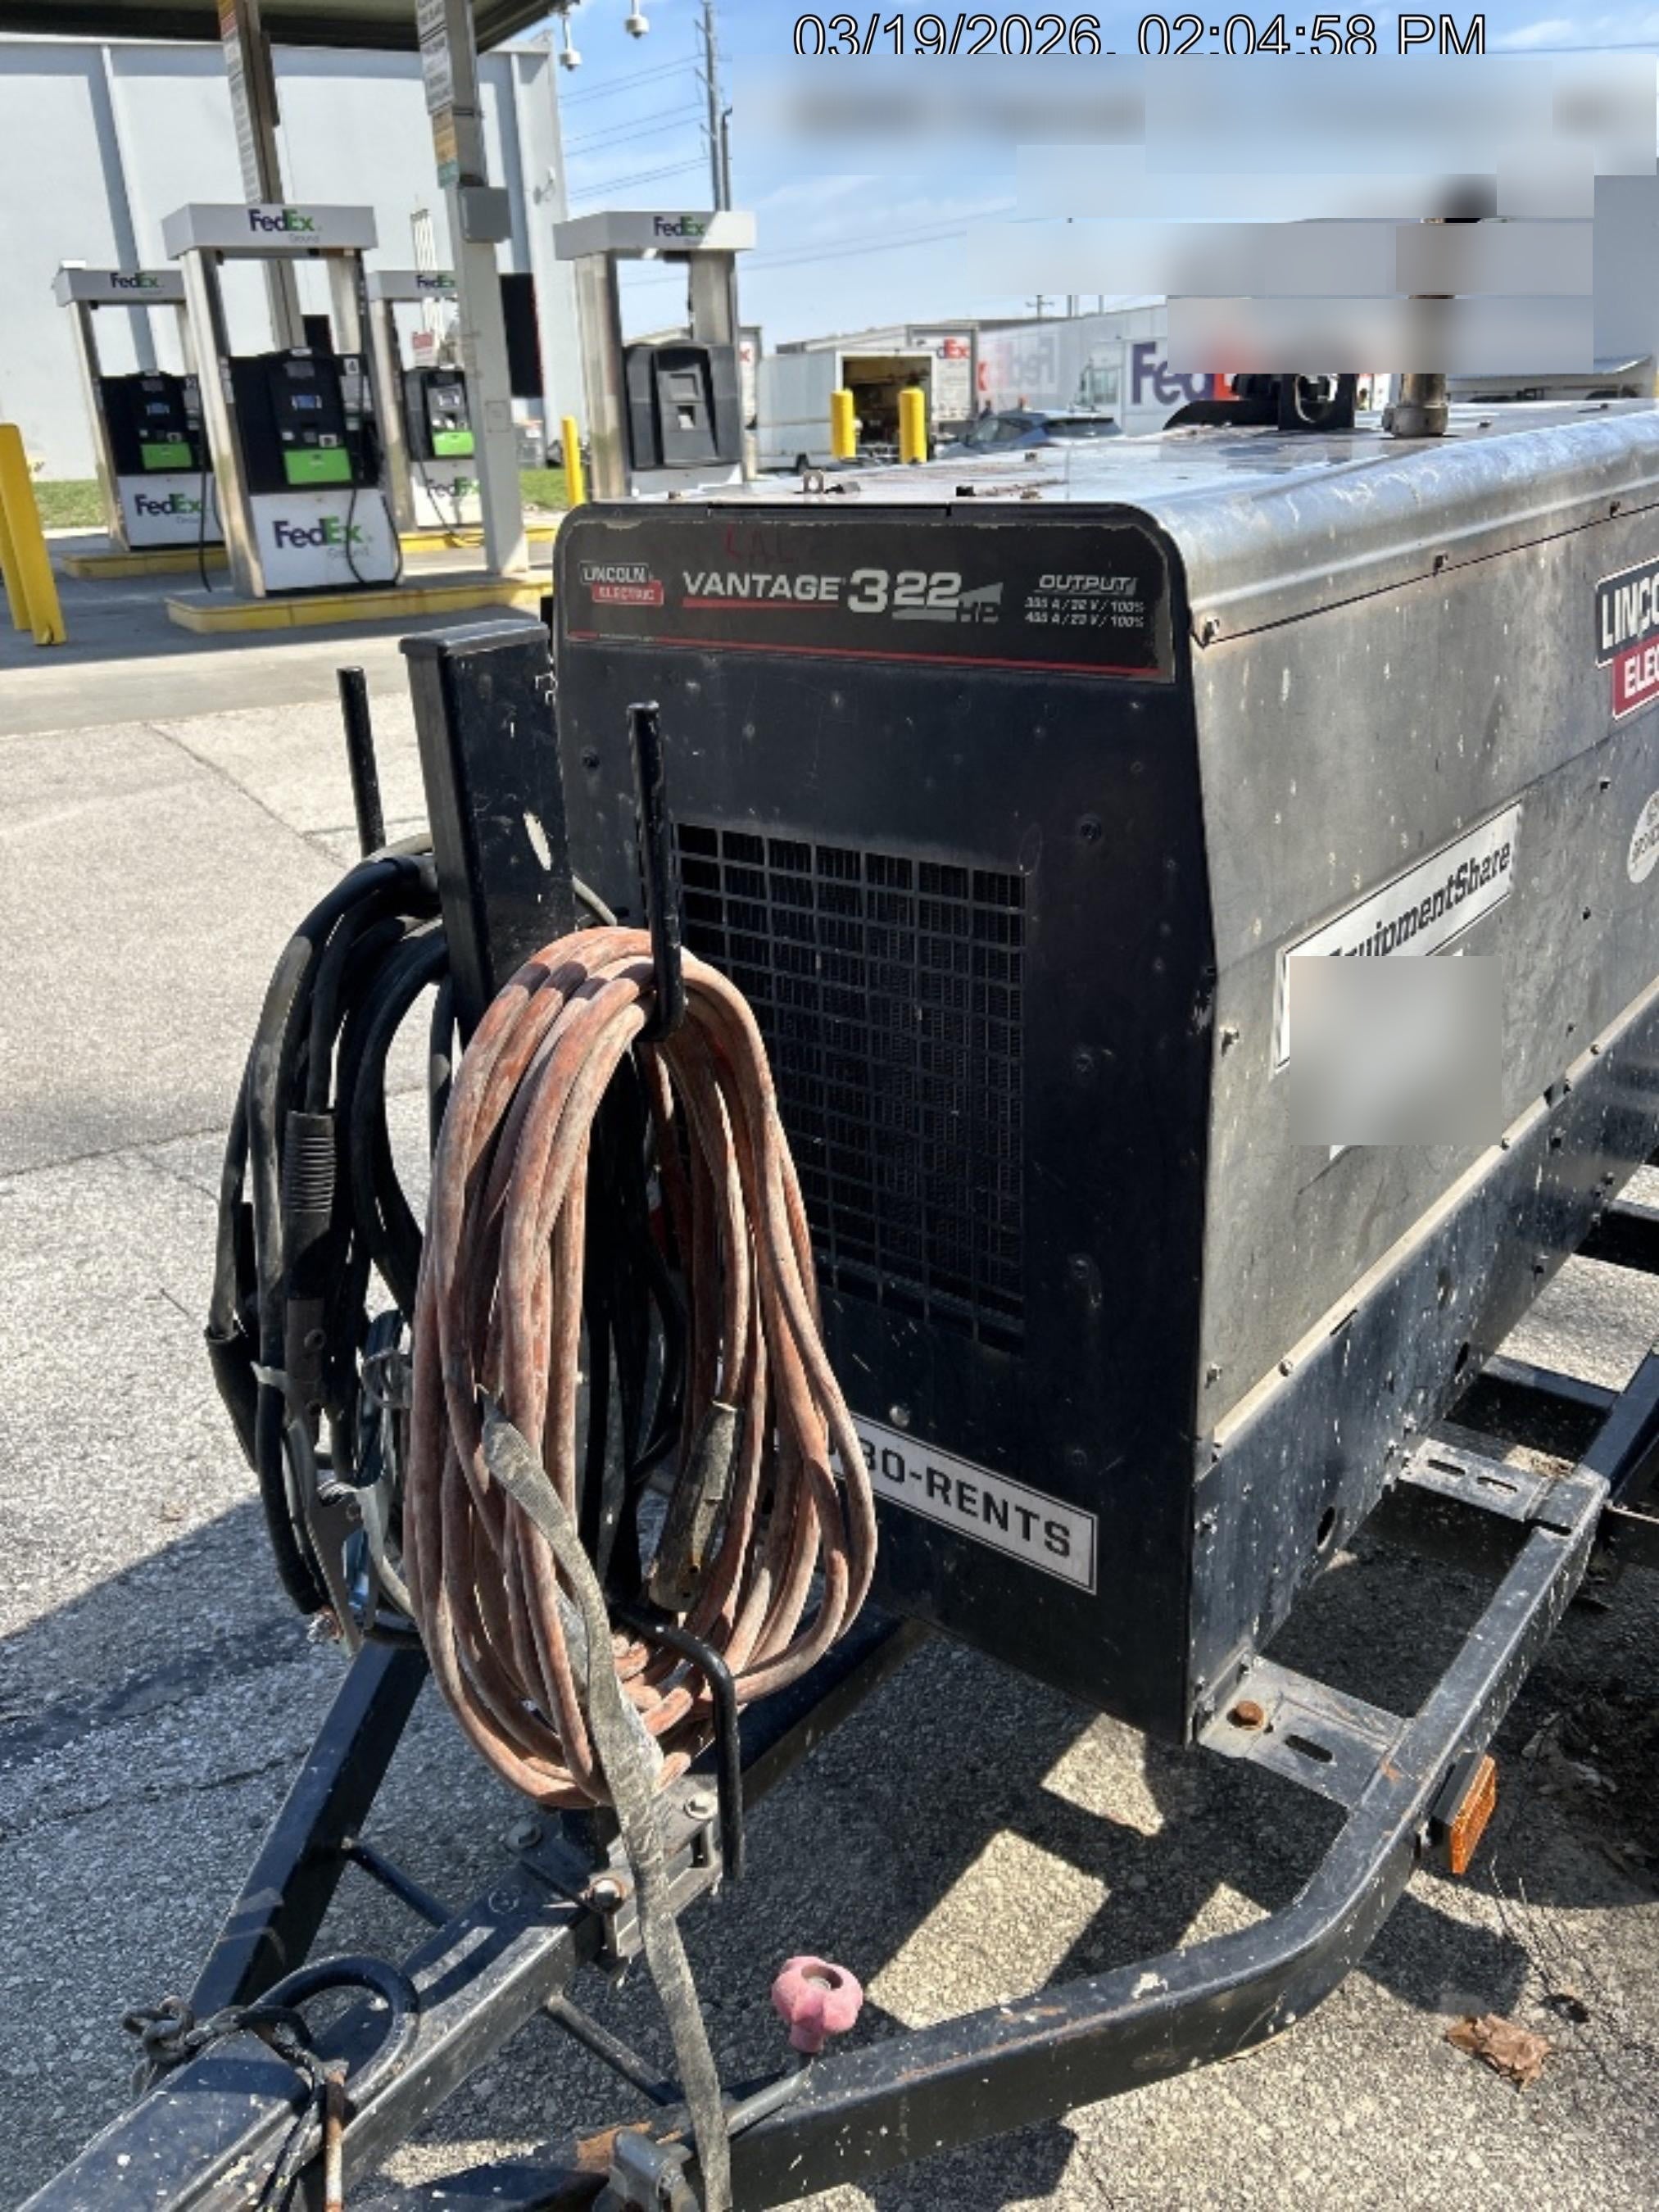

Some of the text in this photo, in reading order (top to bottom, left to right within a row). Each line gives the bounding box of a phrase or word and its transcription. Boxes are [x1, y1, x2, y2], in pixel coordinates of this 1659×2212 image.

[248, 208, 315, 232] FedEx
[654, 215, 705, 237] FedEx
[110, 272, 158, 288] FedEx
[273, 516, 363, 548] FedEx
[582, 566, 646, 583] LINCOLN
[1039, 574, 1131, 591] OUTPUT
[599, 586, 655, 601] ELECTRIC
[683, 572, 841, 601] VANTAGE
[847, 569, 962, 613] 322
